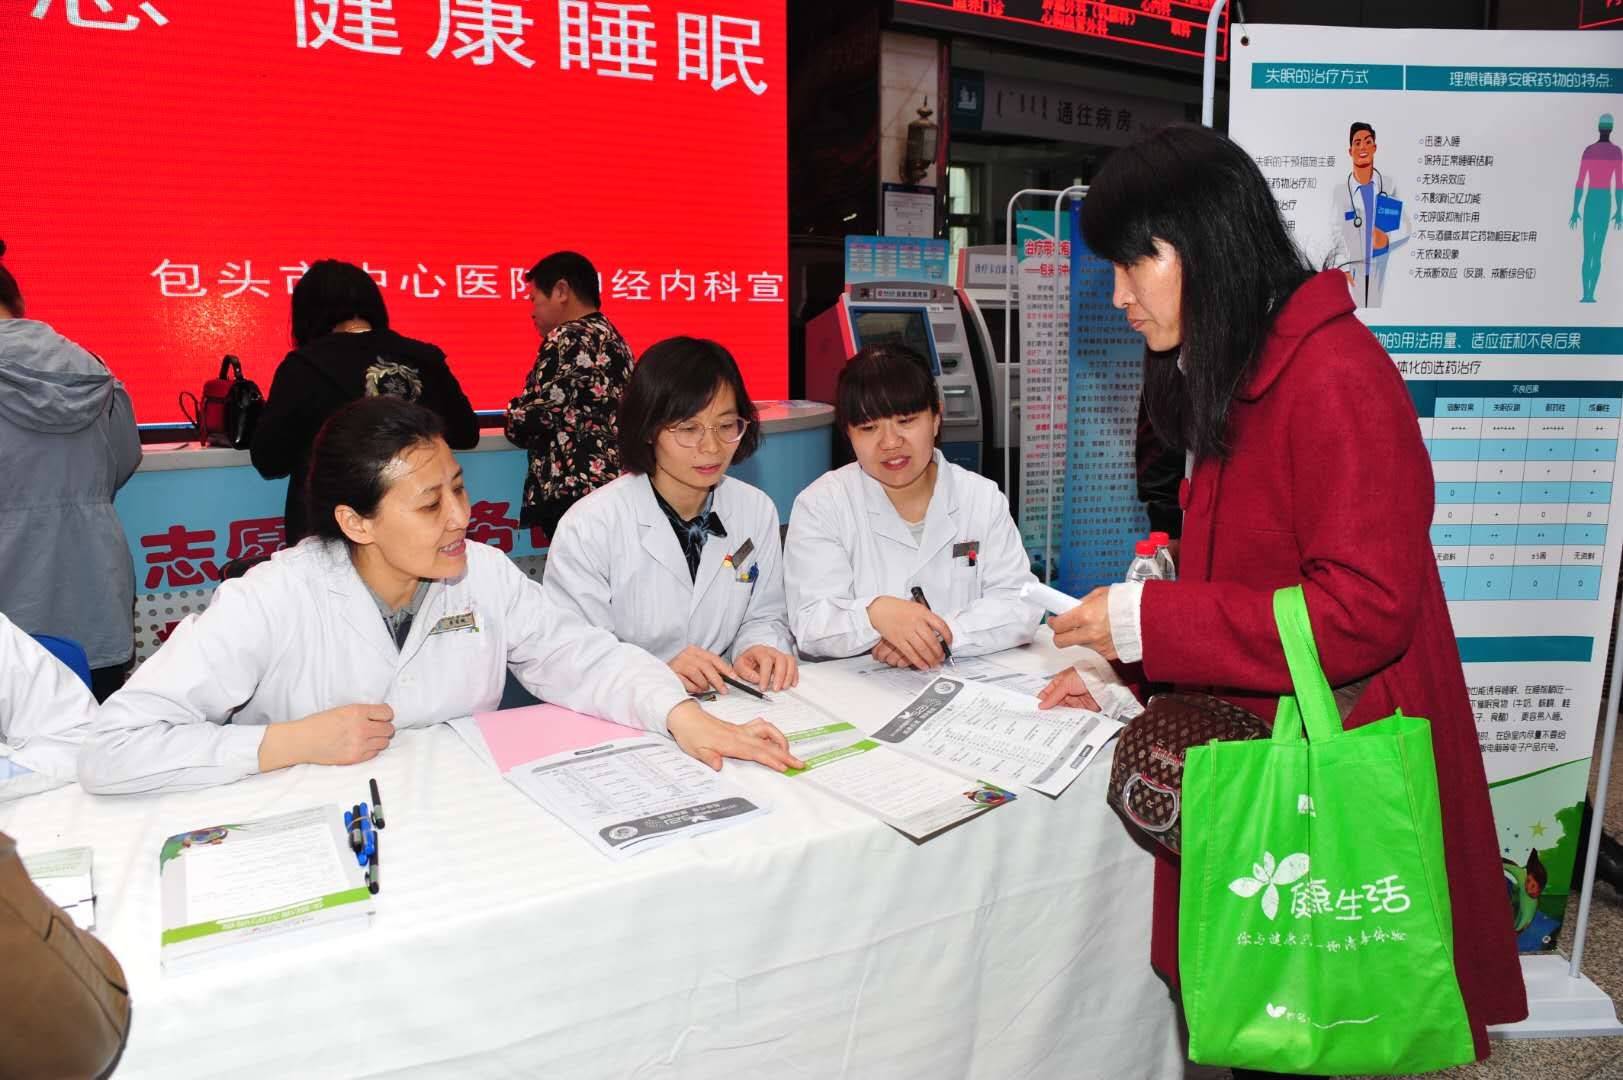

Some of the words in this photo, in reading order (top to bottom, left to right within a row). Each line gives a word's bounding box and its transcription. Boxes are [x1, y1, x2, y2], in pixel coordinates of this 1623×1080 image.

[1264, 68, 1370, 85] 失眠的治疗方式
[1056, 99, 1134, 132] 通往病房
[1424, 136, 1461, 147] 迅速入睡
[1424, 154, 1494, 167] 保持正常睡眠结构
[1421, 174, 1466, 186] 无残余效应
[1420, 192, 1482, 205] 不影响记忆功能
[1418, 211, 1480, 223] 无呼吸抑制作用
[1512, 384, 1540, 394] 不良后果
